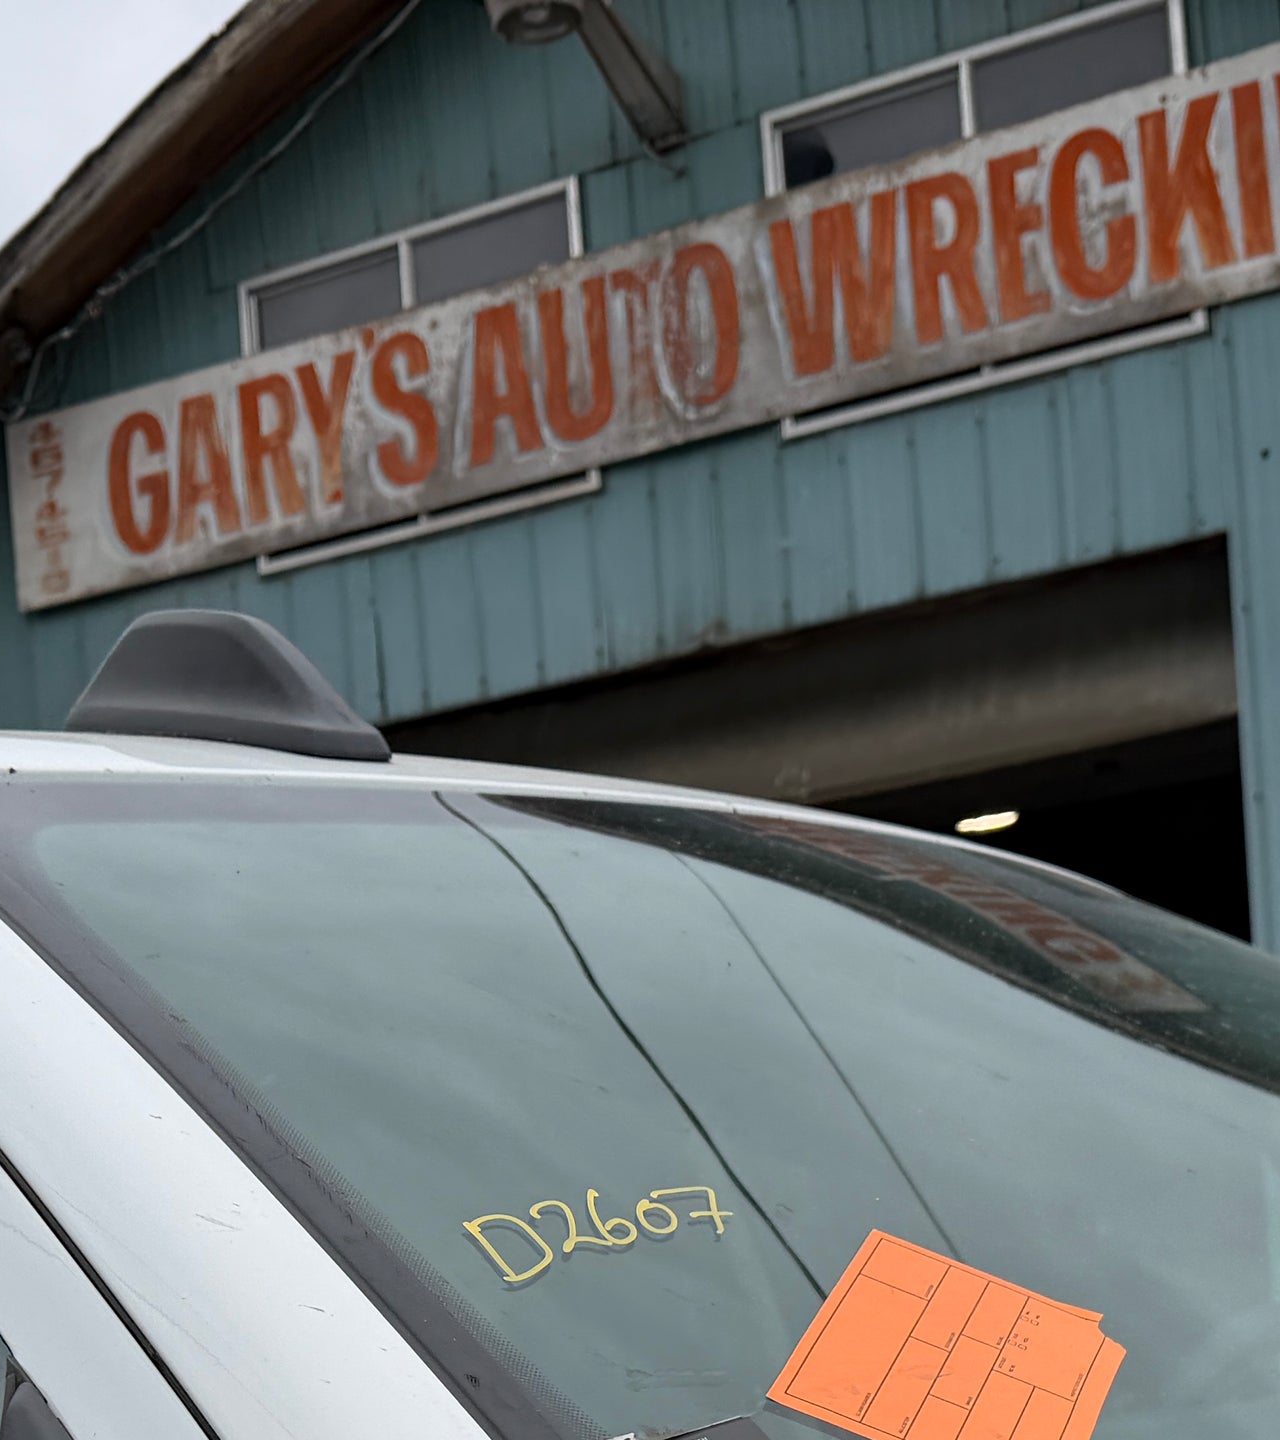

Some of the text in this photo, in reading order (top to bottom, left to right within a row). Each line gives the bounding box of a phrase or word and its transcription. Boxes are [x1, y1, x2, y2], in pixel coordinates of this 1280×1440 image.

[107, 328, 440, 556] GARY'S
[466, 242, 741, 468] AUTO
[462, 1186, 734, 1282] D2607
